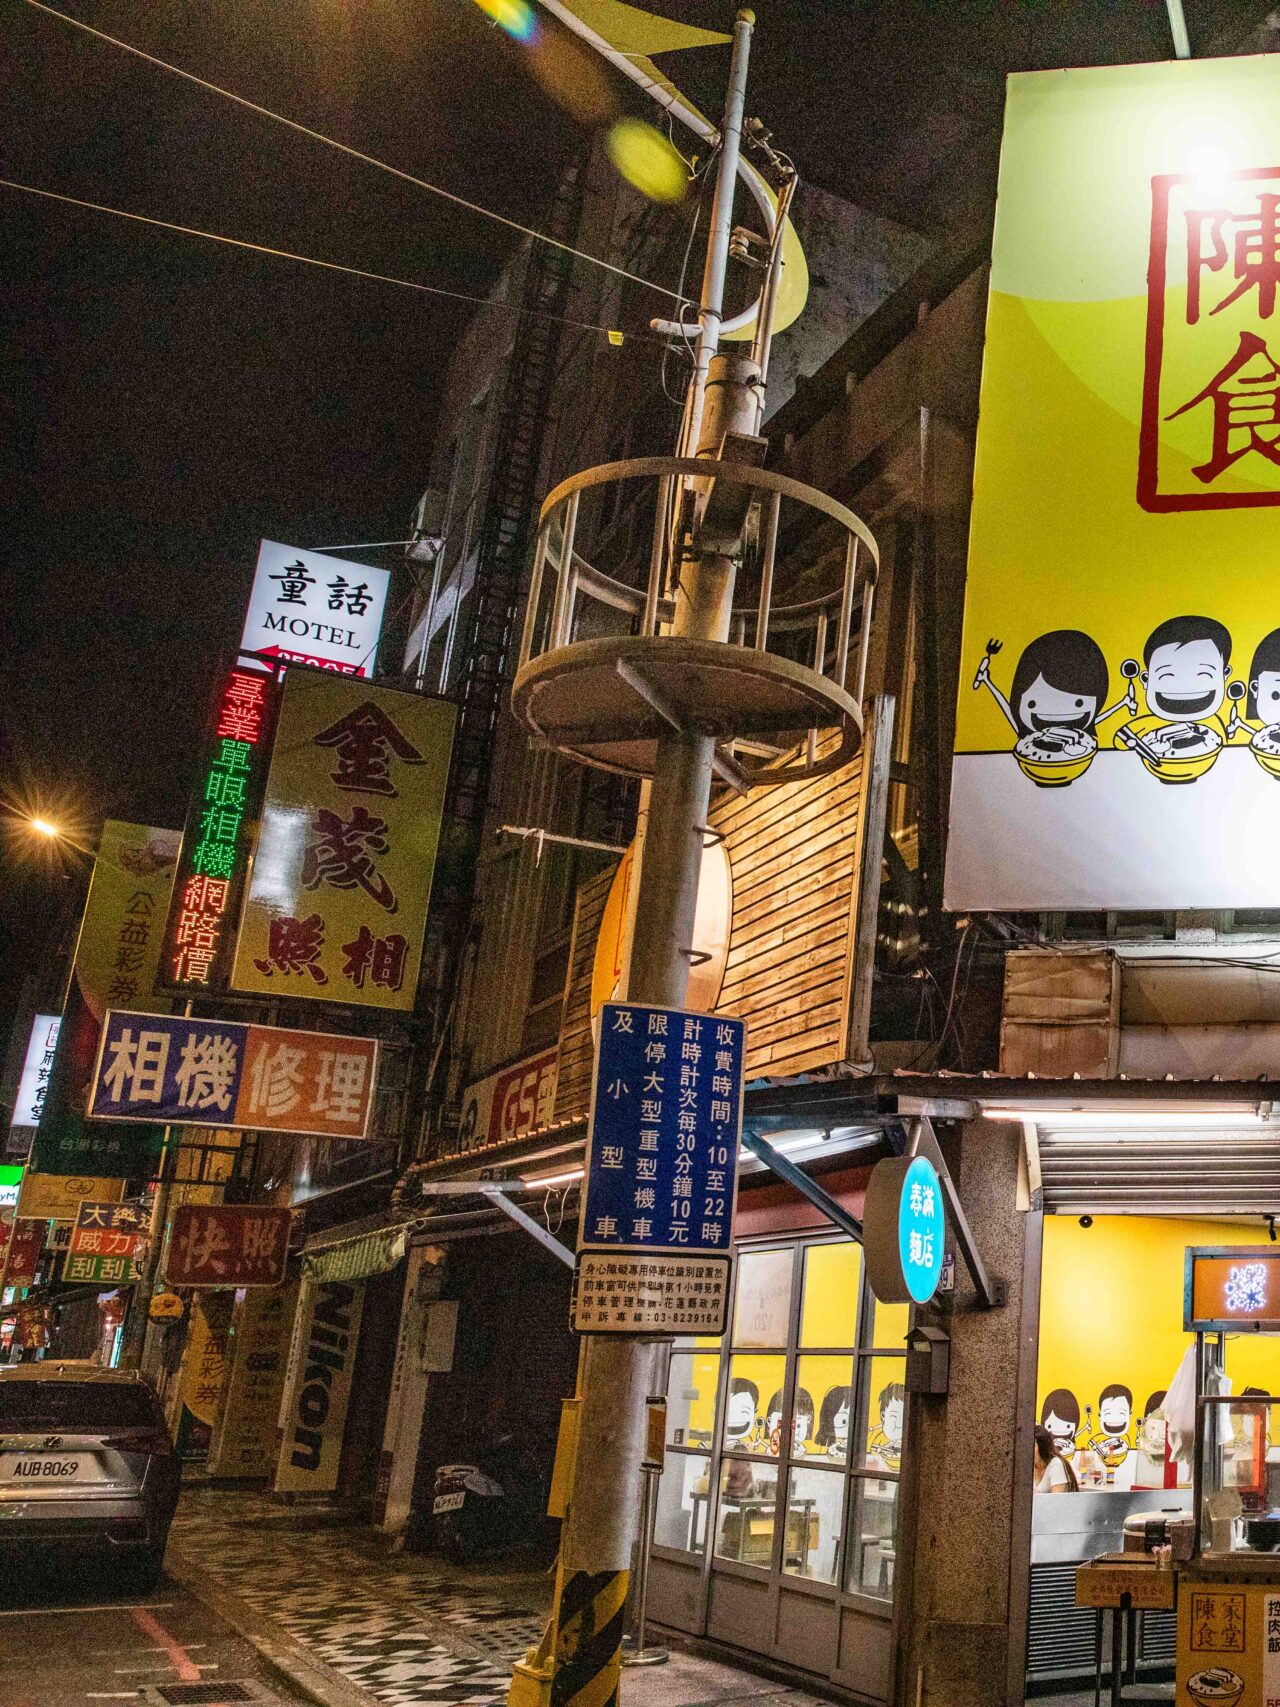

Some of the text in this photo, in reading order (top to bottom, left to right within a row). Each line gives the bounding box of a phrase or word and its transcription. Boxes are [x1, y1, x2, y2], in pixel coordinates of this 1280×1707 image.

[268, 559, 373, 616] 童話
[262, 611, 361, 649] MOTEL
[103, 1028, 367, 1122] 相機修理
[594, 1010, 635, 1239] 及小型車
[631, 1014, 669, 1241] 限停大型重型機車
[13, 1461, 79, 1476] AUB-8069
